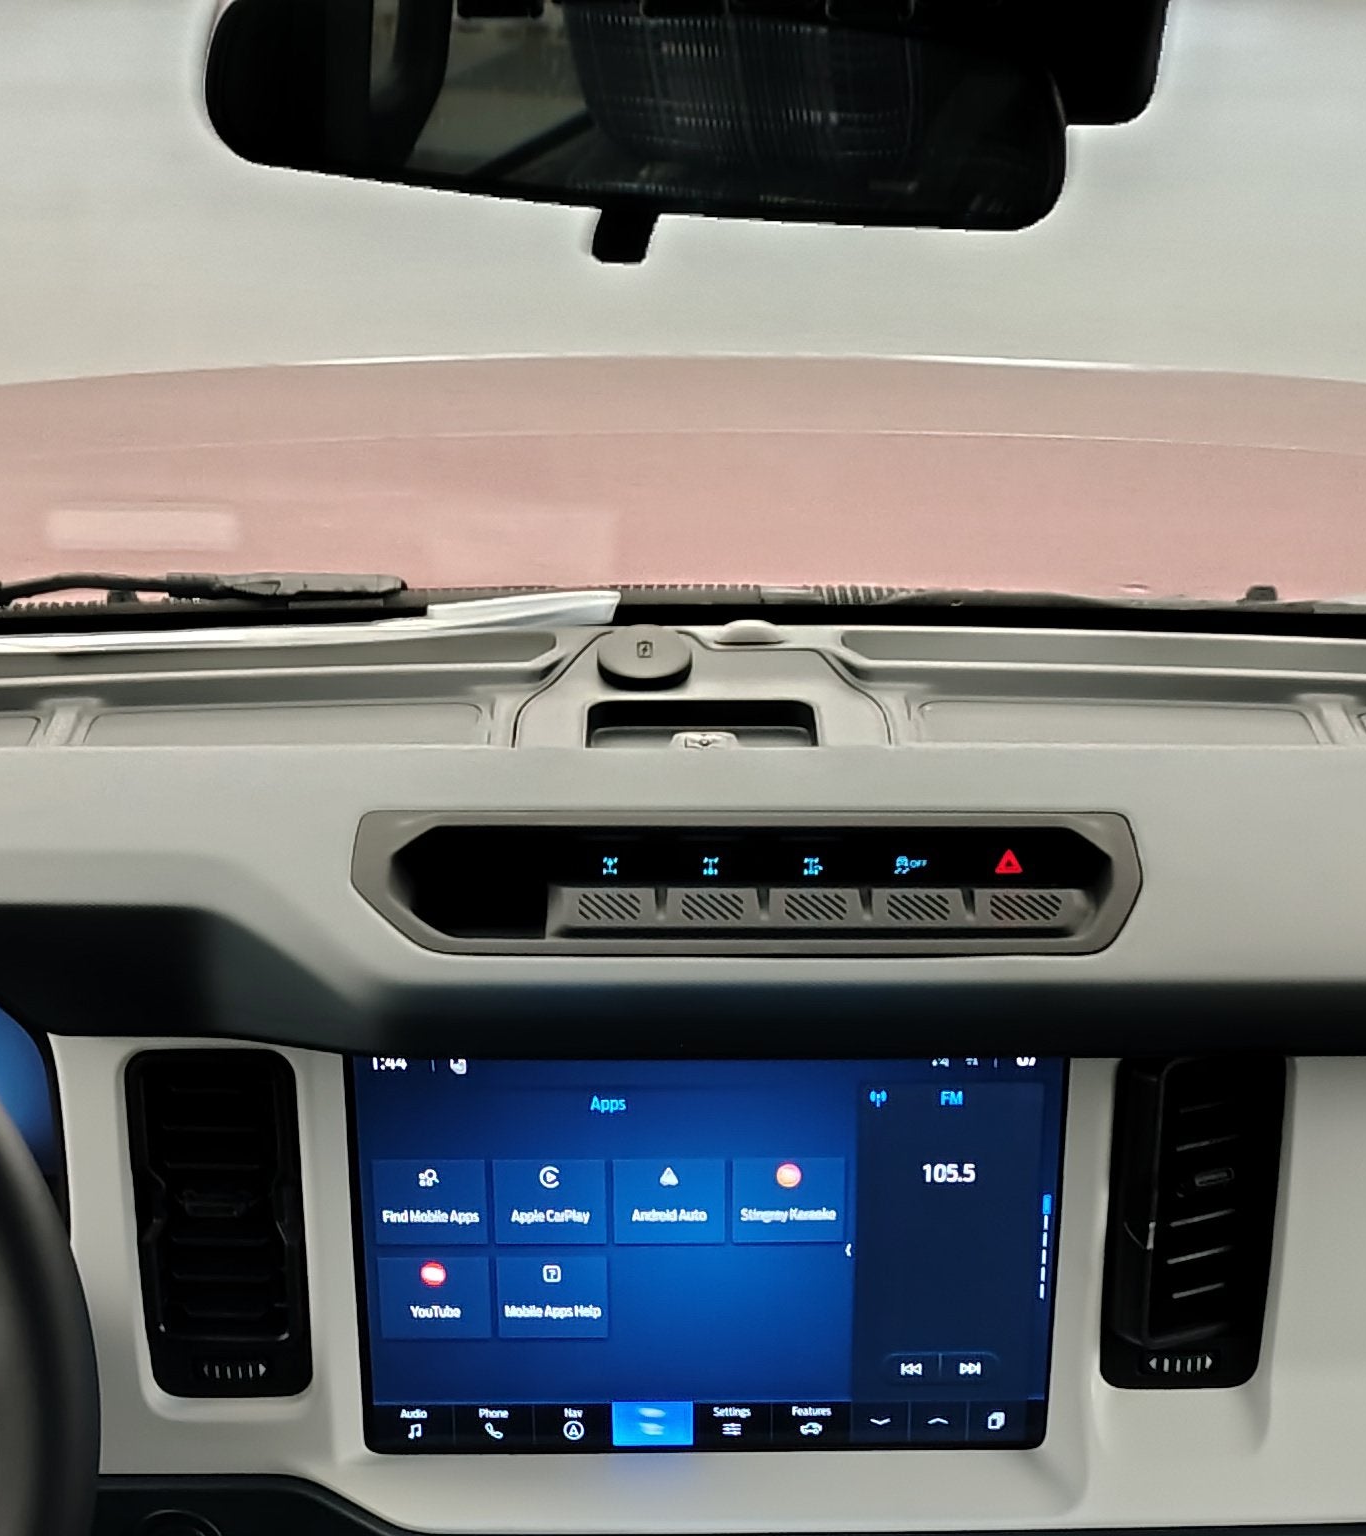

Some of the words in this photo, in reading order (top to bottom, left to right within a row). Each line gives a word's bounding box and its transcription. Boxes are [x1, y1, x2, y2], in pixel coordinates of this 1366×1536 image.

[372, 1057, 407, 1070] 1:44
[590, 1095, 626, 1112] Apps
[940, 1090, 963, 1105] FM
[922, 1163, 976, 1183] 105.5
[382, 1210, 408, 1223] Find
[410, 1210, 448, 1223] Mobile
[450, 1210, 479, 1225] Apps
[511, 1209, 544, 1225] Apple
[546, 1209, 590, 1224] CarPlay
[632, 1208, 677, 1222] Android
[679, 1208, 707, 1222] Auto
[410, 1305, 461, 1319] YouTube
[505, 1305, 543, 1318] Mobile
[544, 1305, 574, 1320] Apps
[574, 1305, 602, 1320] Help
[400, 1408, 427, 1419] Audio
[479, 1408, 509, 1419] Phone
[564, 1408, 583, 1418] Nav
[713, 1406, 751, 1418] Settings
[792, 1406, 832, 1417] Features
